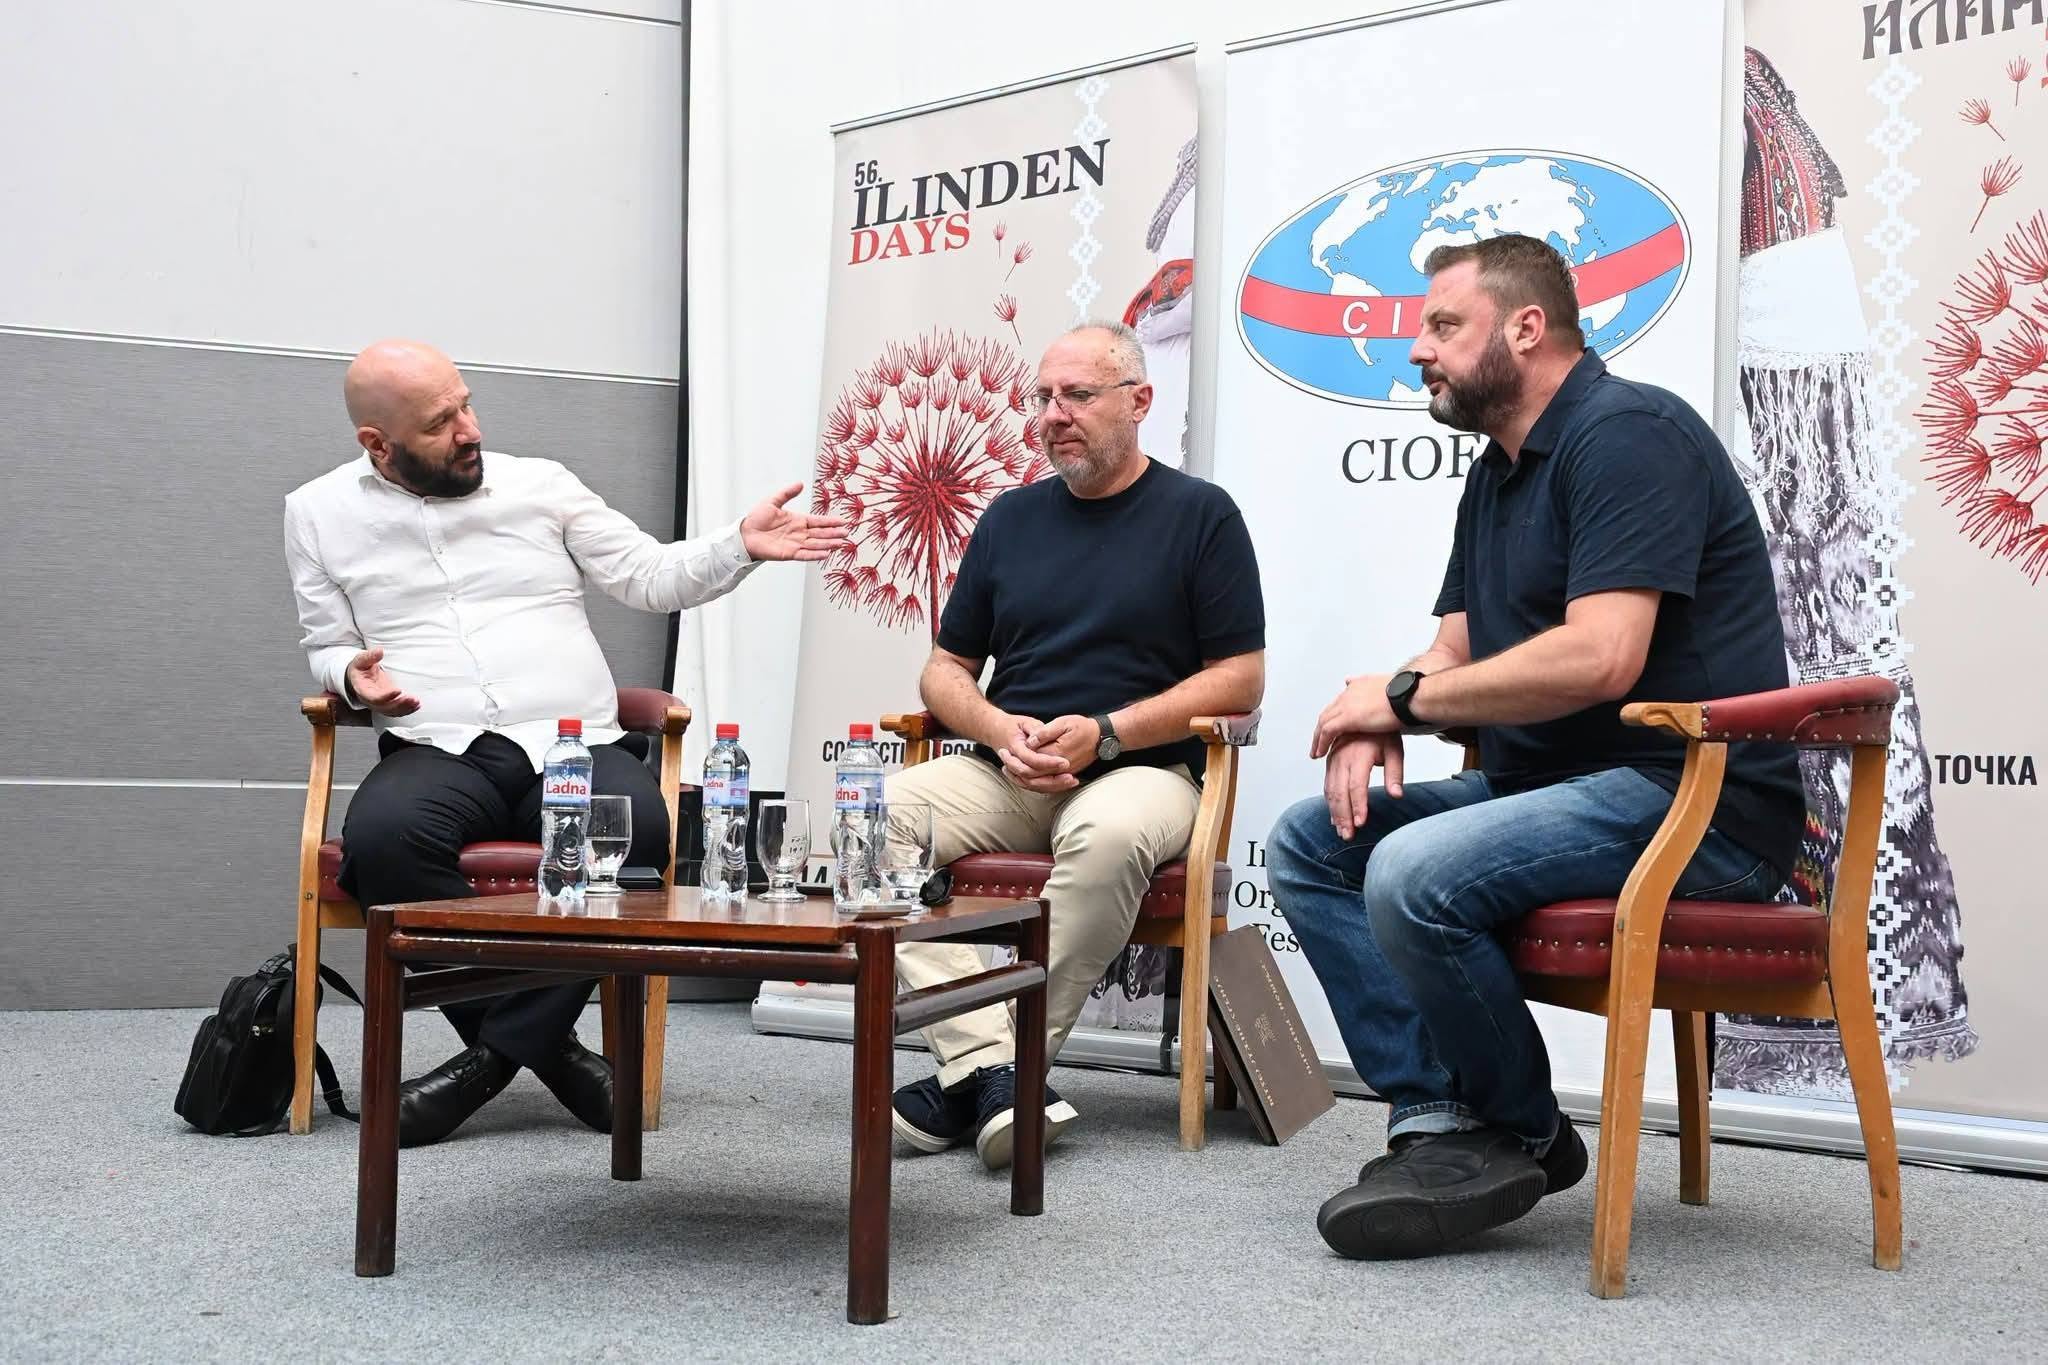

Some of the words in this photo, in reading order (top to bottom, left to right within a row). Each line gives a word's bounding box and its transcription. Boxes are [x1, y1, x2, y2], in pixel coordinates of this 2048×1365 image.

[1863, 0, 2048, 60] ИЛИН
[850, 138, 1111, 231] ILINDEN
[854, 159, 883, 187] 56.
[847, 211, 970, 266] DAYS
[1341, 432, 1481, 484] CIOF
[545, 780, 587, 795] Ladna
[1934, 754, 2038, 786] ТОЧКА
[835, 787, 859, 801] dna
